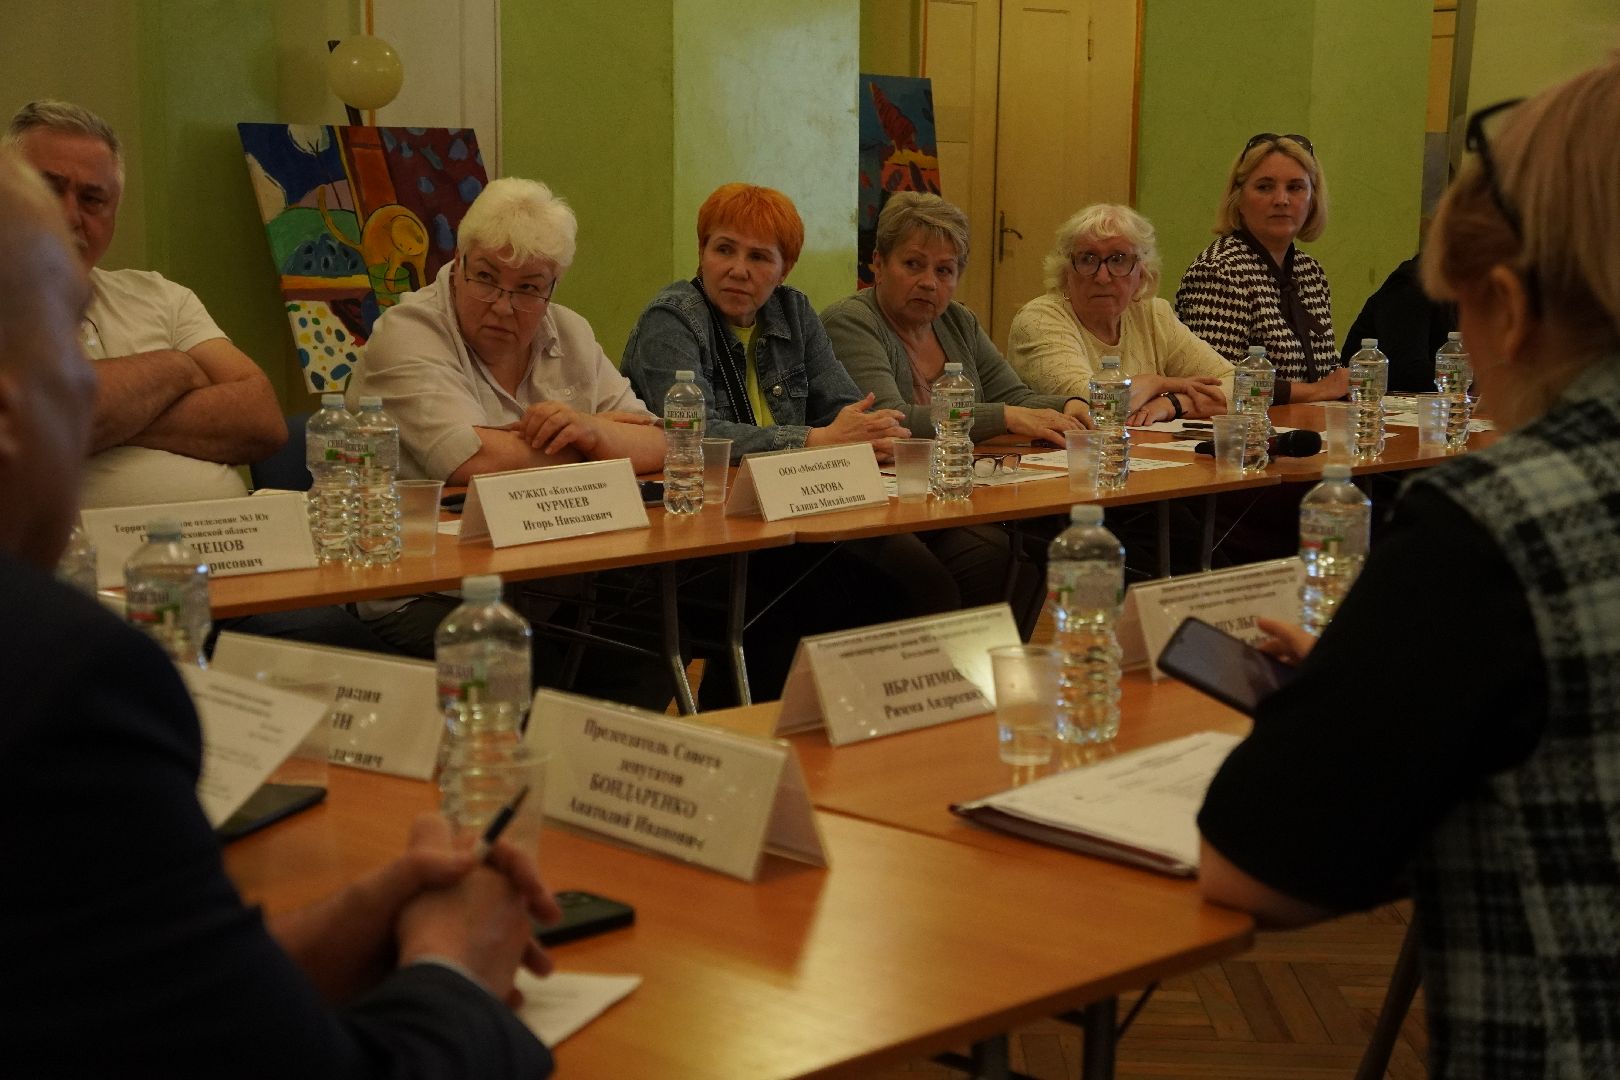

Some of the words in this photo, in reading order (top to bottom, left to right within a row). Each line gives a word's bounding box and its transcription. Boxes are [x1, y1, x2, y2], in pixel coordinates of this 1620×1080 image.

[778, 466, 797, 477] ООО
[508, 487, 548, 501] МУЖККП
[549, 481, 608, 496] «Котельники»
[800, 481, 844, 496] МАХРОВА
[536, 496, 590, 513] ЧУРМЕЕВ
[789, 501, 818, 513] Галина
[819, 494, 866, 508] Михайловна
[522, 516, 554, 531] Игорь
[555, 510, 613, 527] Николаевич
[180, 527, 223, 540] осковской
[225, 526, 258, 537] области
[191, 538, 245, 556] НЕЦОВ
[209, 558, 264, 574] рисович
[588, 773, 698, 819] БОНДАРЕНКО
